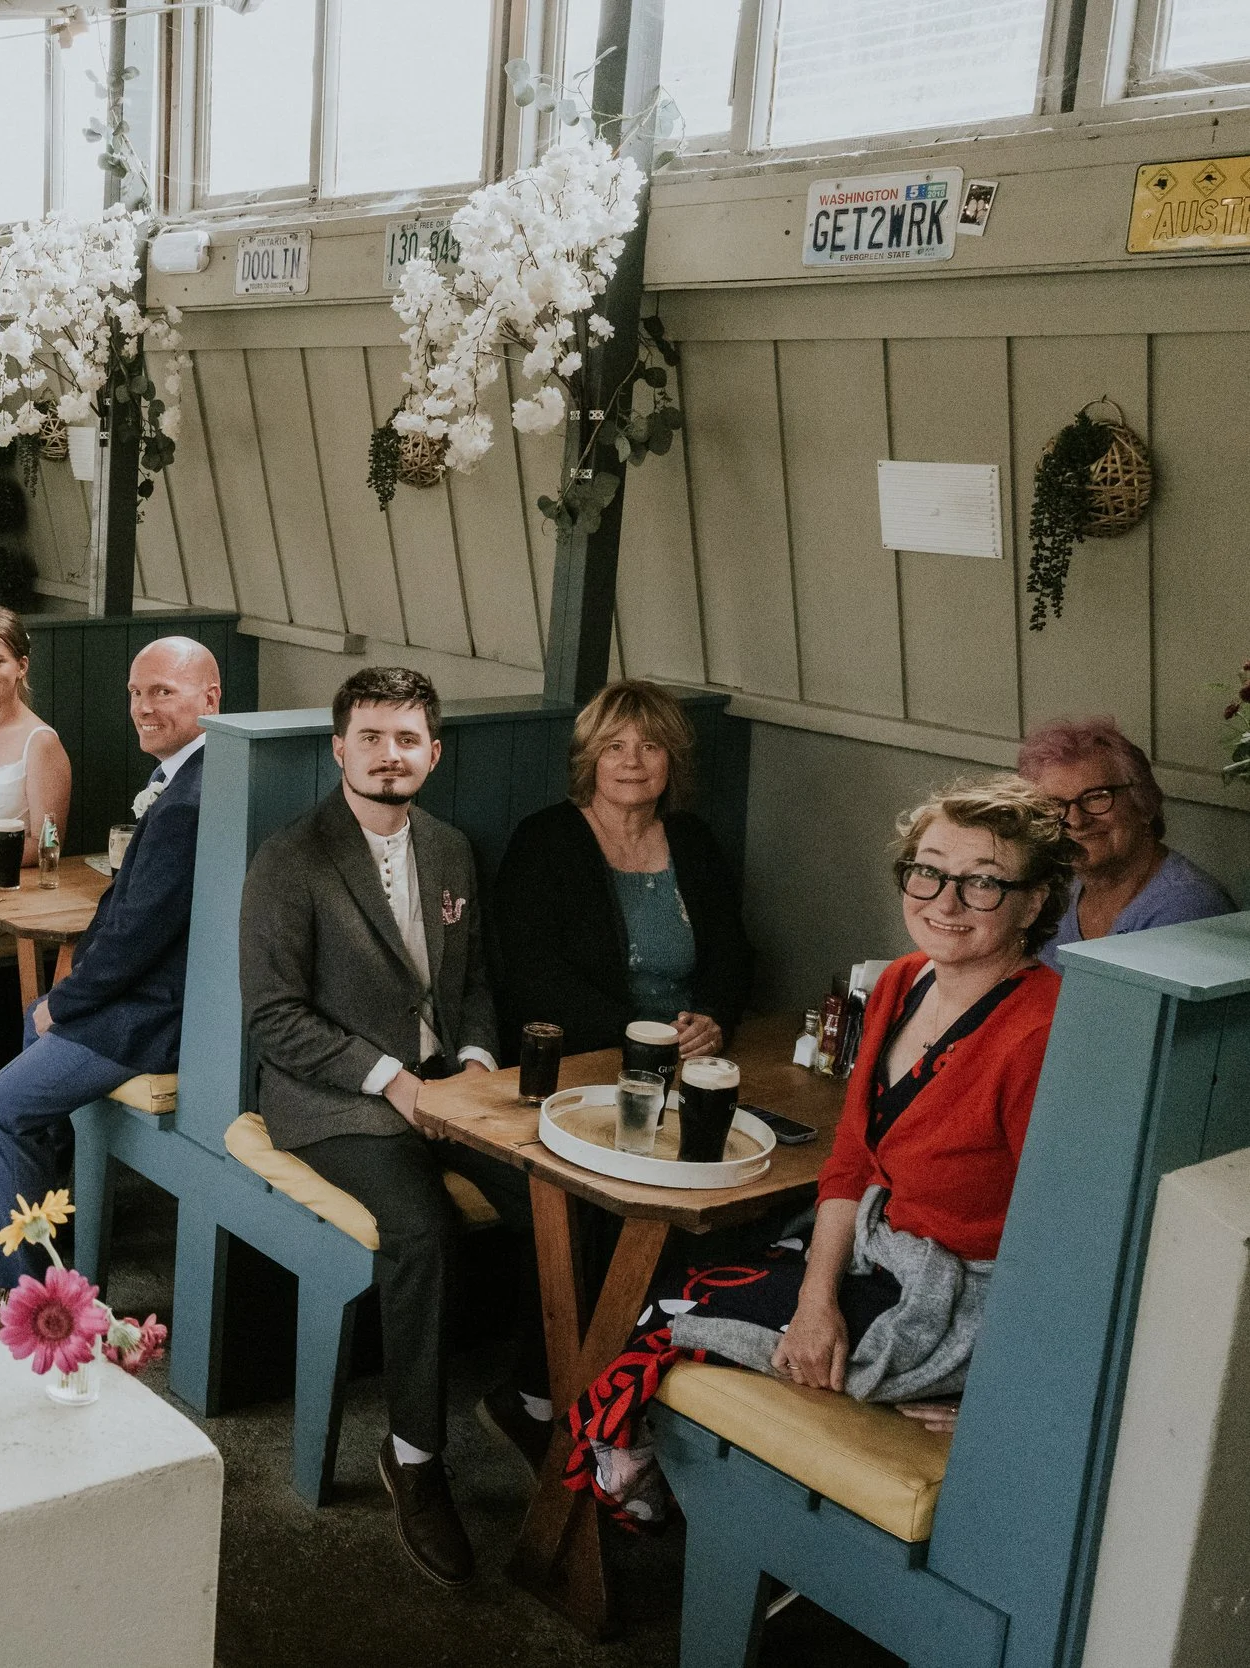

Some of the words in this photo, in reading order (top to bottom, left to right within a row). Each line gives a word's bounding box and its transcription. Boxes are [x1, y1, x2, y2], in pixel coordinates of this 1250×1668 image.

[819, 188, 899, 206] WASHINGTON
[909, 184, 919, 198] 5
[420, 221, 434, 230] FREE
[436, 220, 444, 228] OR
[812, 200, 949, 252] GET2WRK
[257, 236, 288, 247] ONTARIO
[840, 252, 884, 262] EVERGREEN
[887, 250, 911, 259] STATE
[241, 247, 302, 281] DOOLIN
